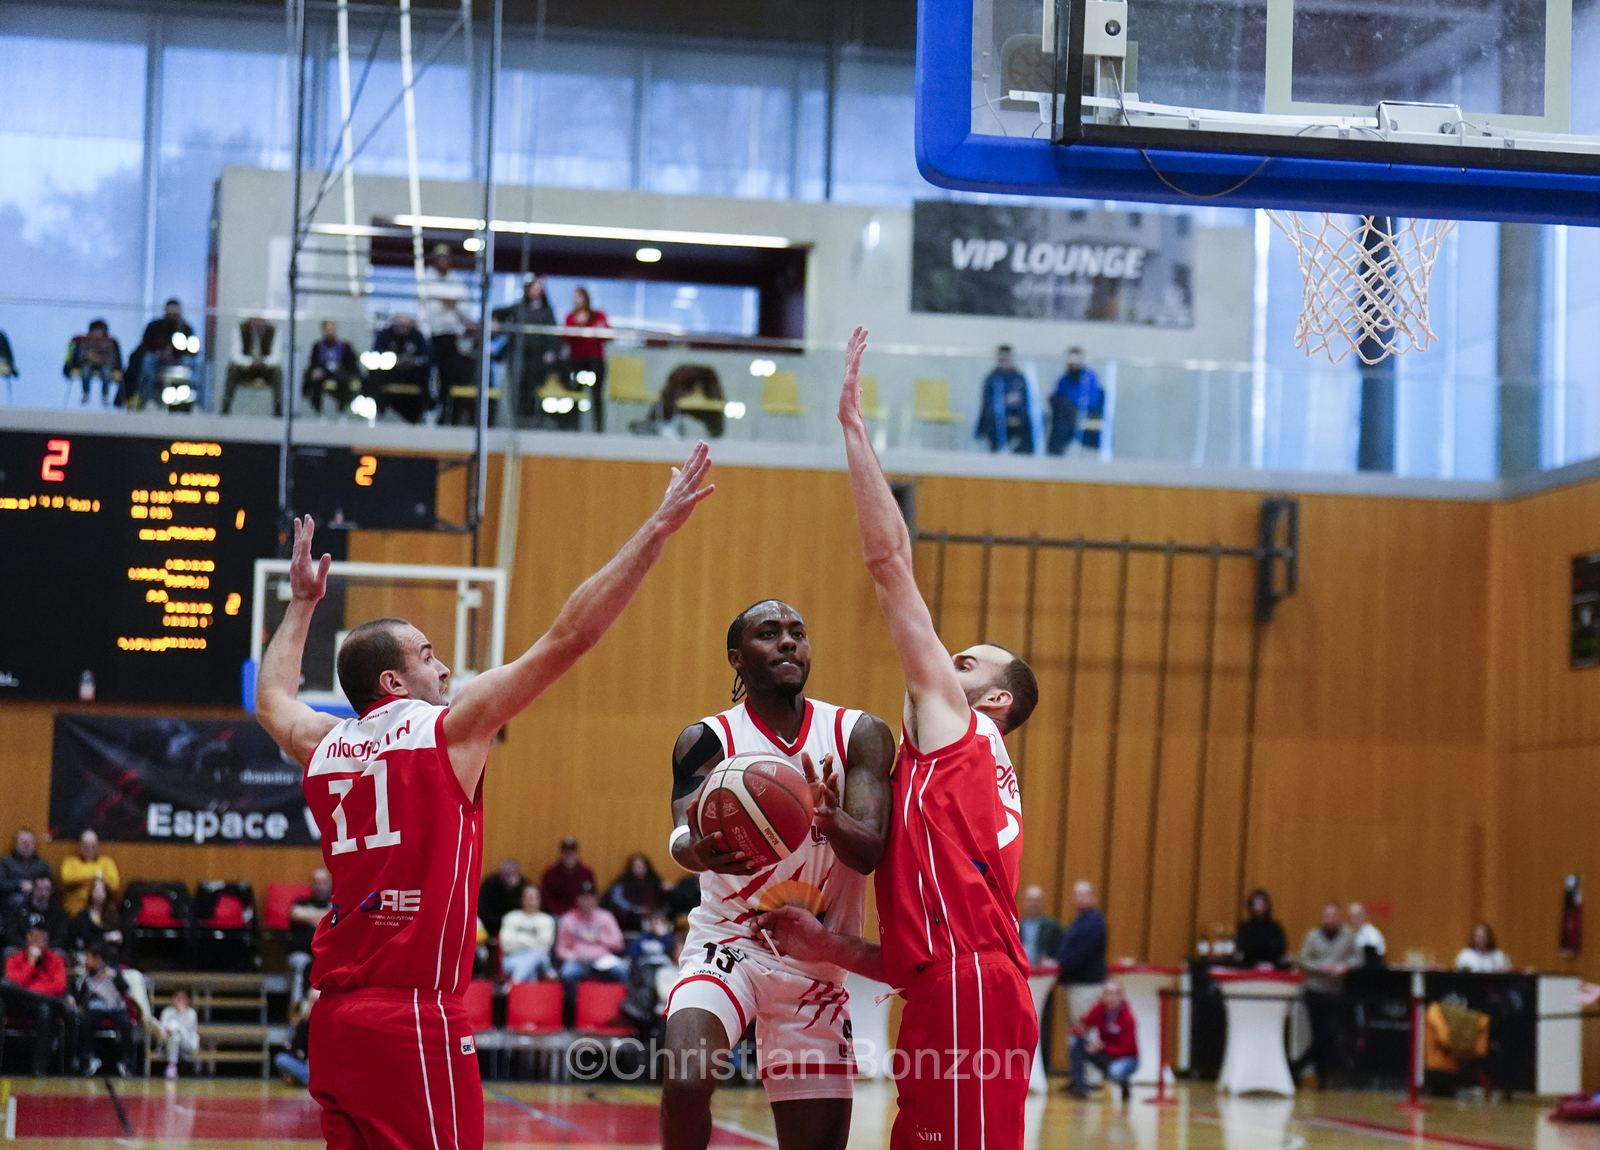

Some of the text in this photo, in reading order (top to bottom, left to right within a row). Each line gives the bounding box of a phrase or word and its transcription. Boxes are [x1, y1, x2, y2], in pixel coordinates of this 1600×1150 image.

[951, 237, 1146, 280] VIP LOUNGE
[41, 439, 71, 482] 2
[355, 455, 377, 486] 2
[146, 802, 290, 845] Espace
[328, 759, 401, 855] 11
[702, 941, 736, 974] 13
